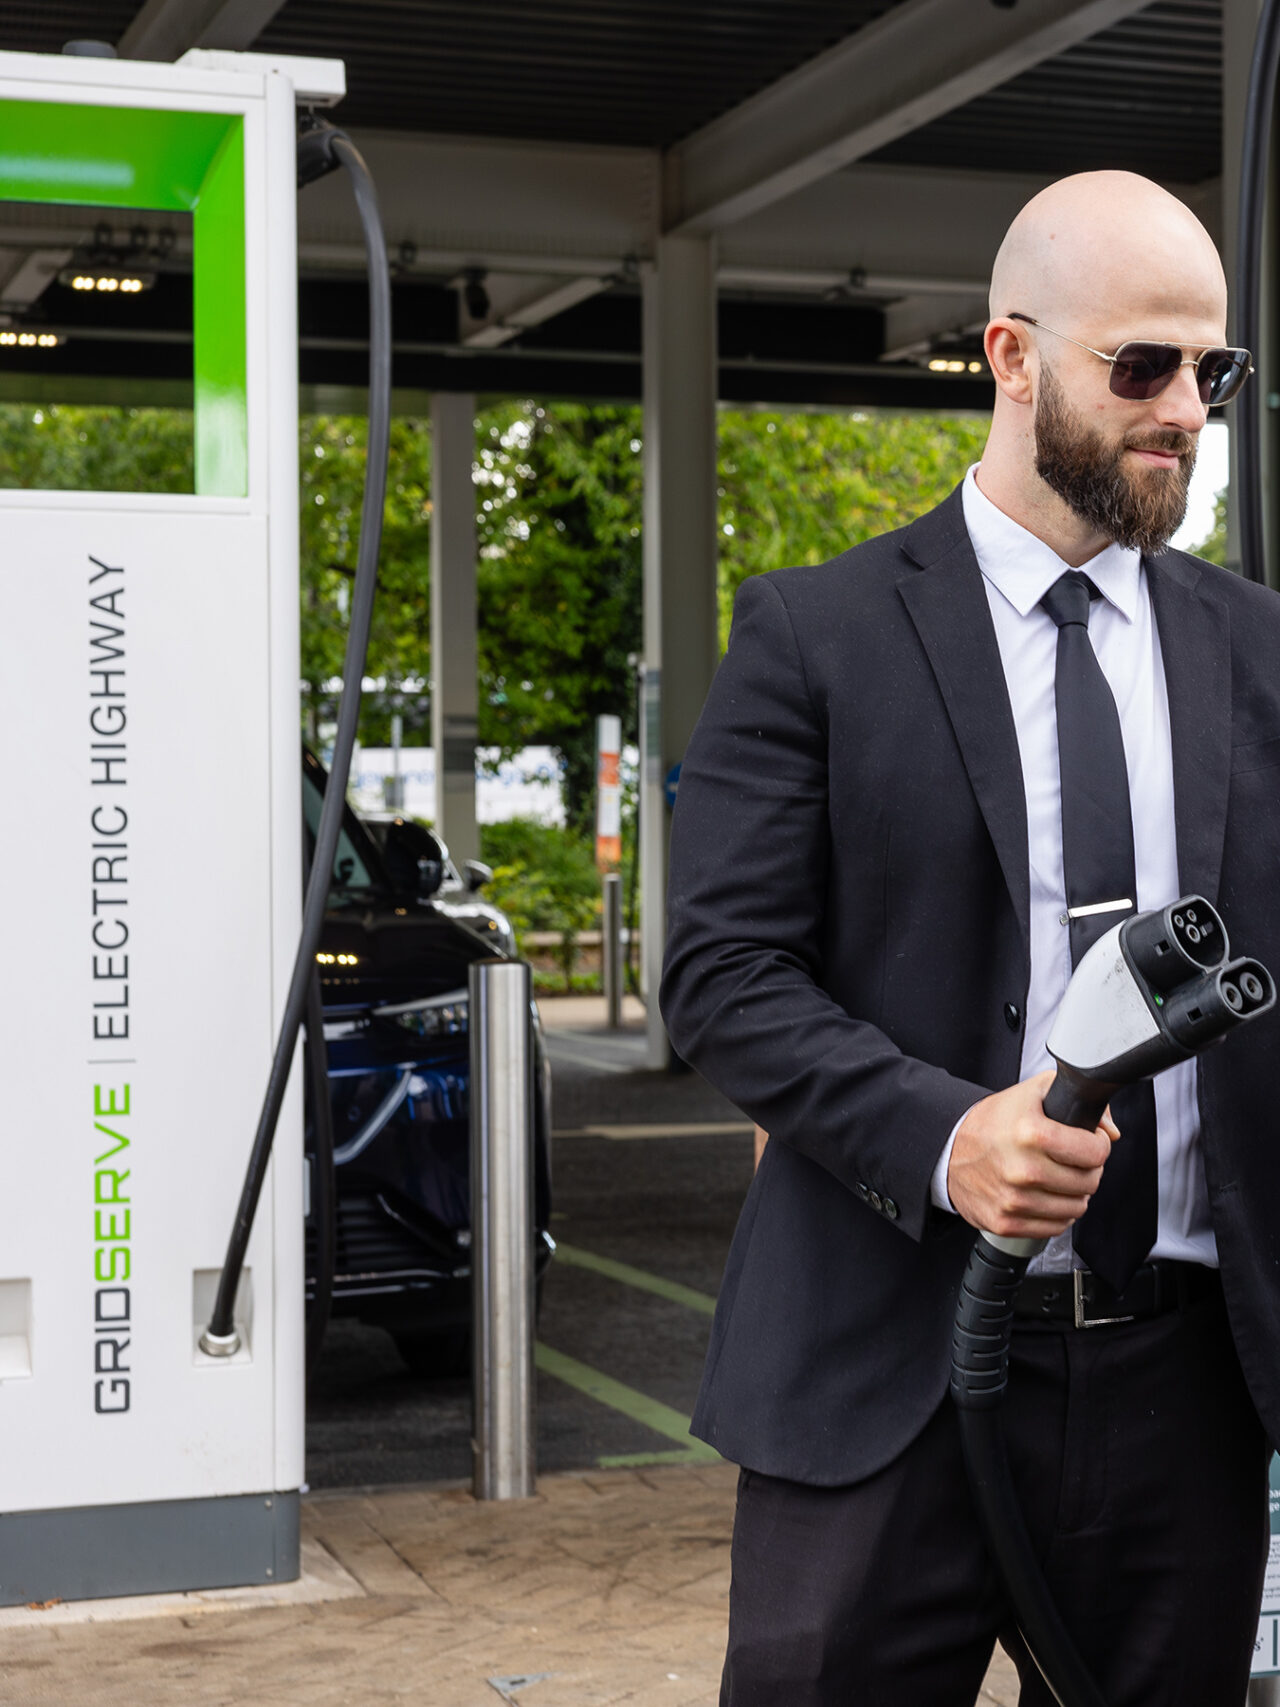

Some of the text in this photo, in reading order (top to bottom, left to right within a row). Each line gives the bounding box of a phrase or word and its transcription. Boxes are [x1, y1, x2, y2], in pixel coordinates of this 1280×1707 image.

[88, 553, 131, 1414] GRIDSERVE ELECTRIC HIGHWAY
